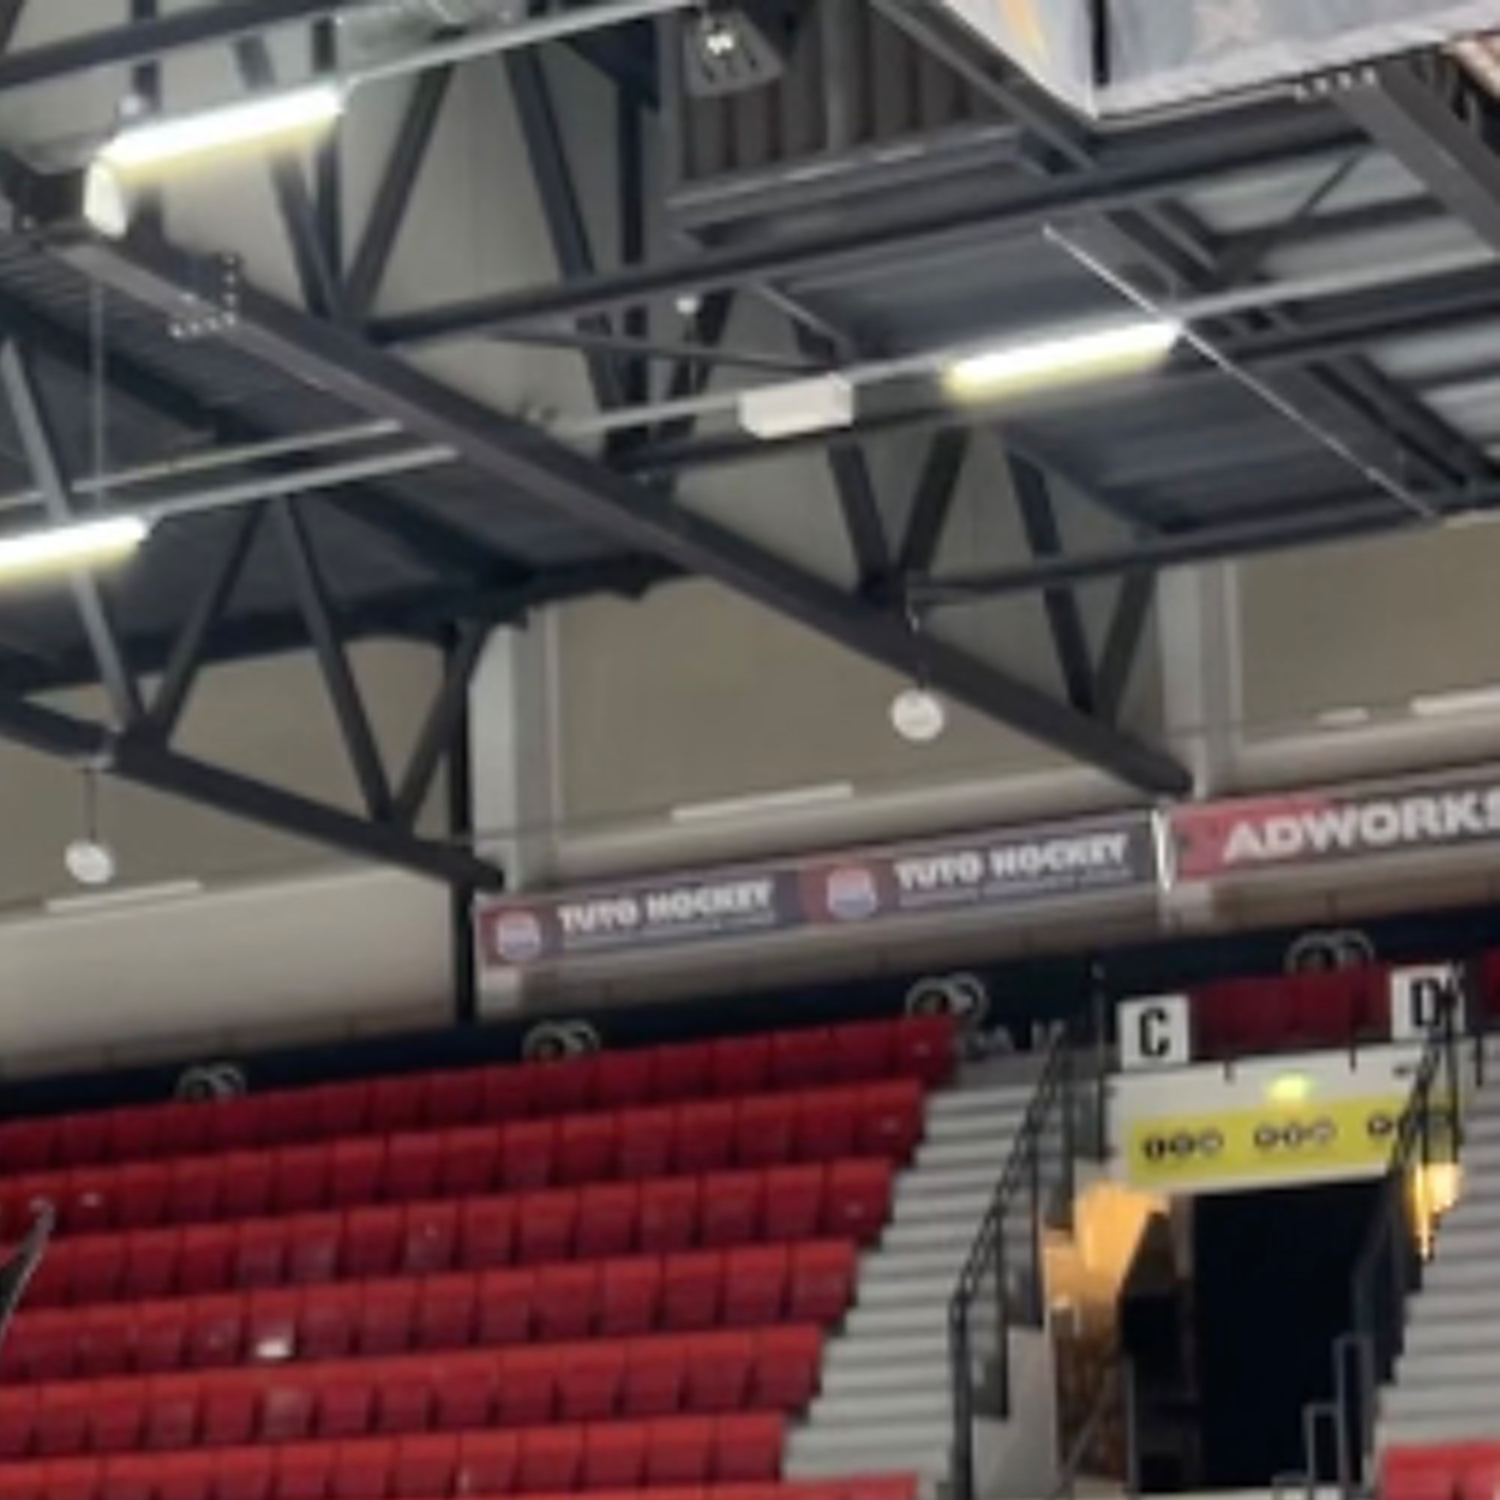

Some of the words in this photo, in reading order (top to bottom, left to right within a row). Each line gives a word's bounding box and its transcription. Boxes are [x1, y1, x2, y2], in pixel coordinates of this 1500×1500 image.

[988, 832, 1130, 878] HOCKEY
[646, 878, 774, 921] HOCKEY
[1137, 1006, 1169, 1058] C
